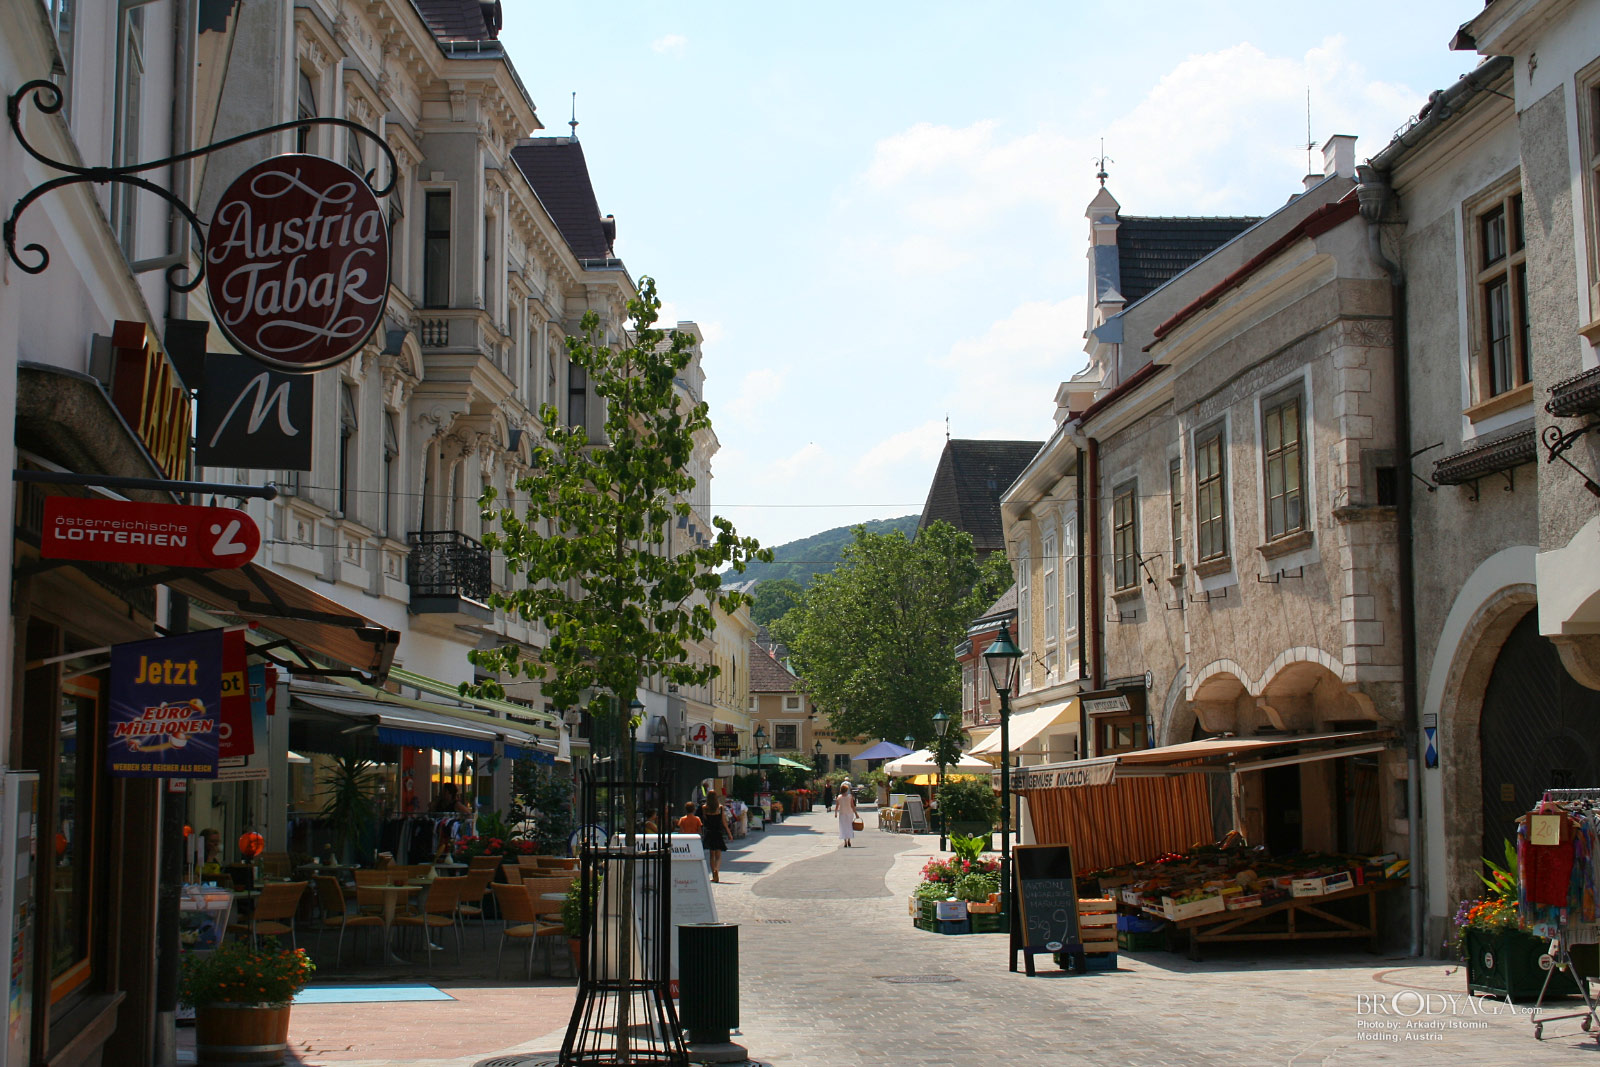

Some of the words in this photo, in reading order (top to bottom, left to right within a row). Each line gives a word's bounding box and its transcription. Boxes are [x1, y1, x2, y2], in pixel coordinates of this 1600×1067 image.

[207, 194, 382, 265] Austria
[222, 248, 384, 326] Tabak
[209, 371, 299, 448] M
[55, 515, 188, 533] österreichische
[54, 527, 188, 547] LOTTERIEN
[135, 655, 198, 685] Jetzt
[142, 706, 193, 720] EURO
[113, 763, 140, 771] WERDEN
[141, 763, 152, 771] SIE
[152, 764, 179, 772] REICHER
[180, 764, 192, 772] ALS
[193, 764, 212, 773] REICH
[1028, 773, 1054, 788] GEMÜSE
